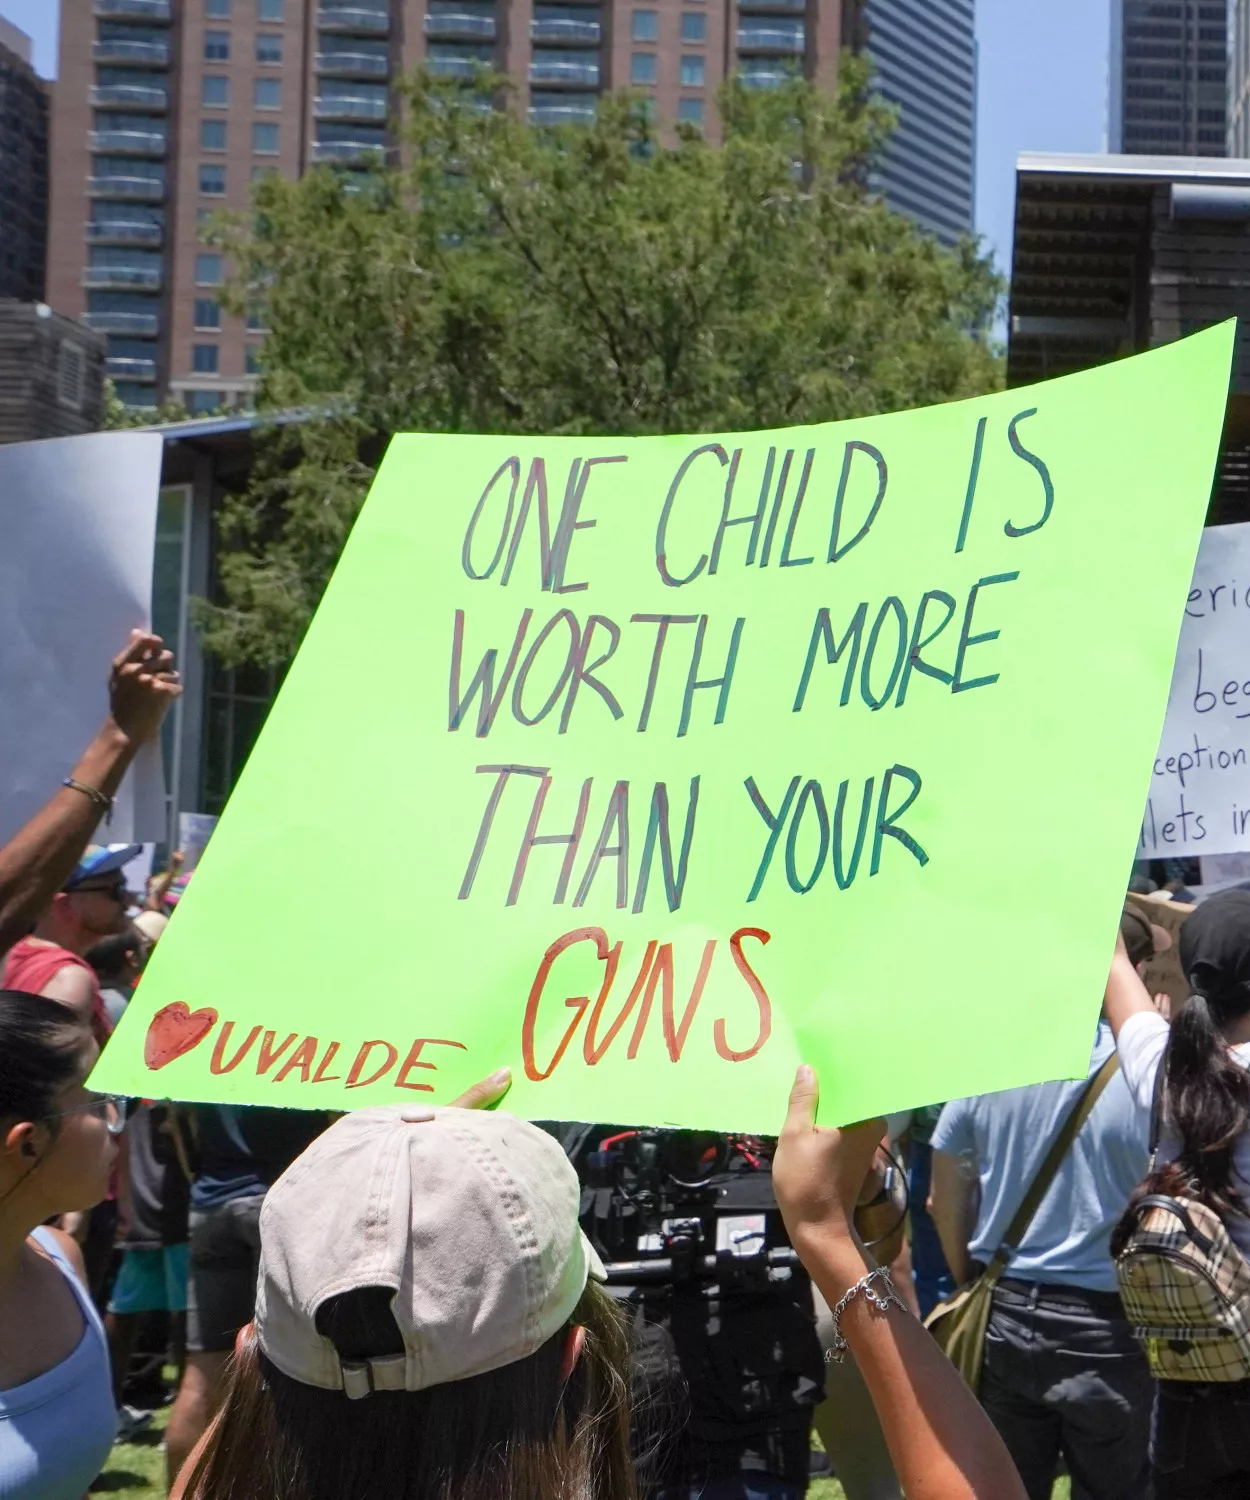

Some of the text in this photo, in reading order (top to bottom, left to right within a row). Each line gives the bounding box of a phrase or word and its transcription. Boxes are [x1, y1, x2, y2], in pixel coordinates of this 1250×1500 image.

[461, 407, 1055, 595] ONE CHILD IS
[447, 570, 1021, 739] WORTH MORE
[1140, 793, 1207, 850] llets
[1153, 732, 1247, 788] ception
[457, 763, 931, 915] THAN YOUR
[210, 1021, 468, 1093] UVALDE
[521, 926, 772, 1082] GUNS
